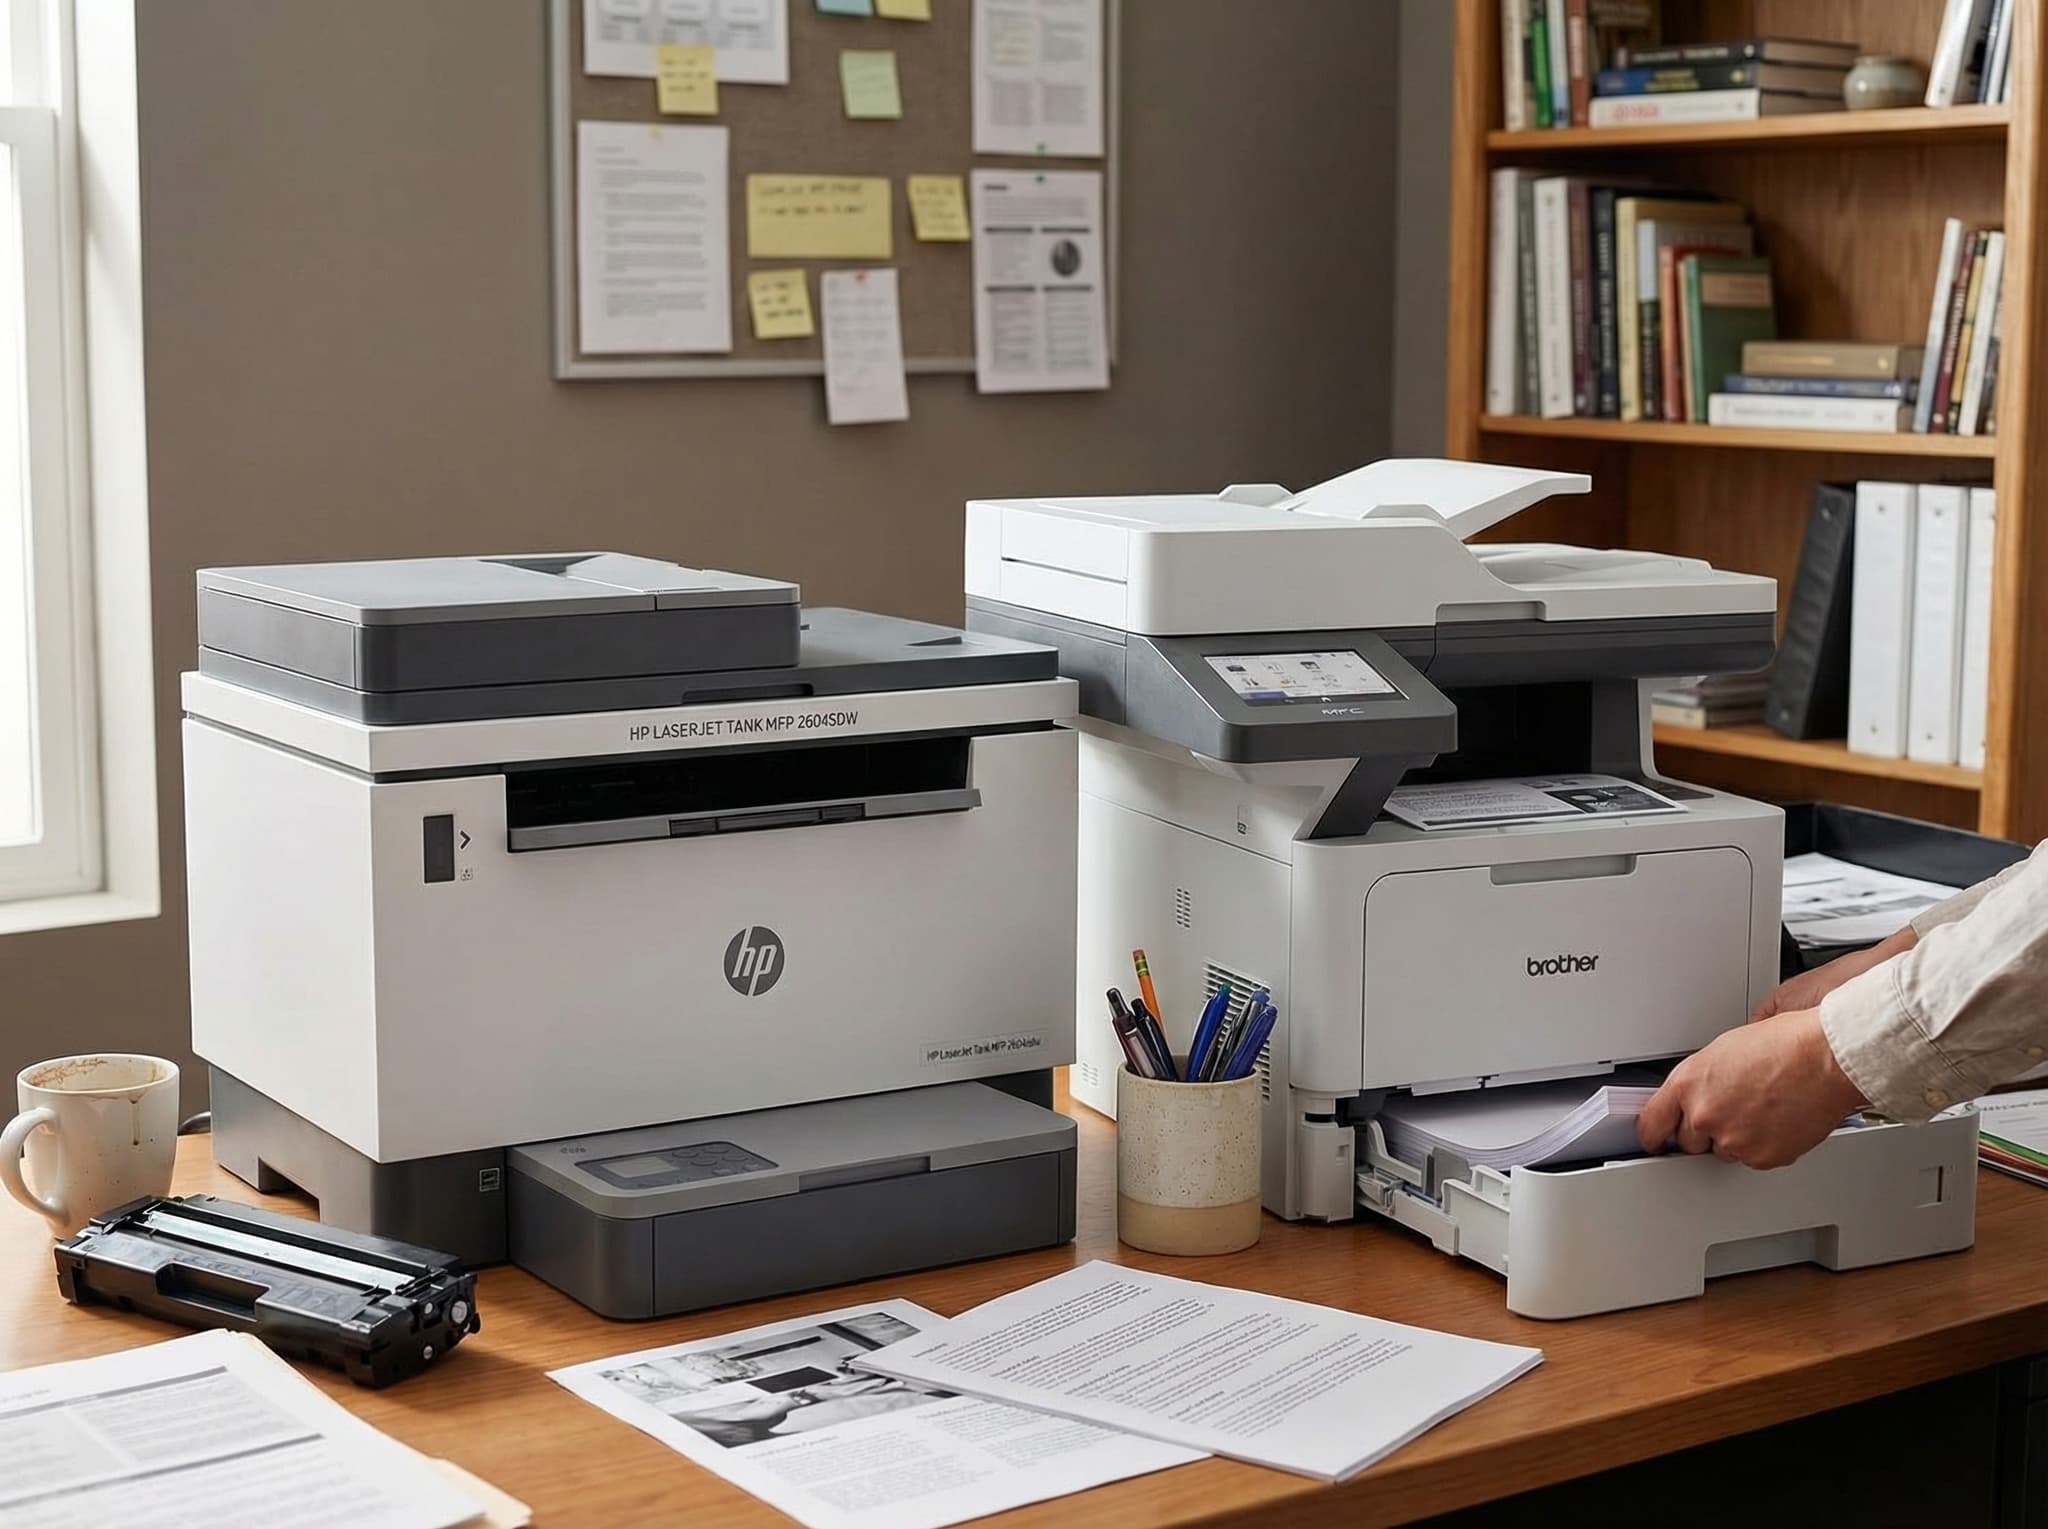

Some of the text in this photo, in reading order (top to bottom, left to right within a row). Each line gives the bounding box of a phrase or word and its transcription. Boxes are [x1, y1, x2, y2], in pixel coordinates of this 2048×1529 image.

[629, 711, 859, 741] HP LASERJET TANK MFP 2604SDW
[731, 926, 778, 996] hp
[1527, 954, 1599, 977] brother
